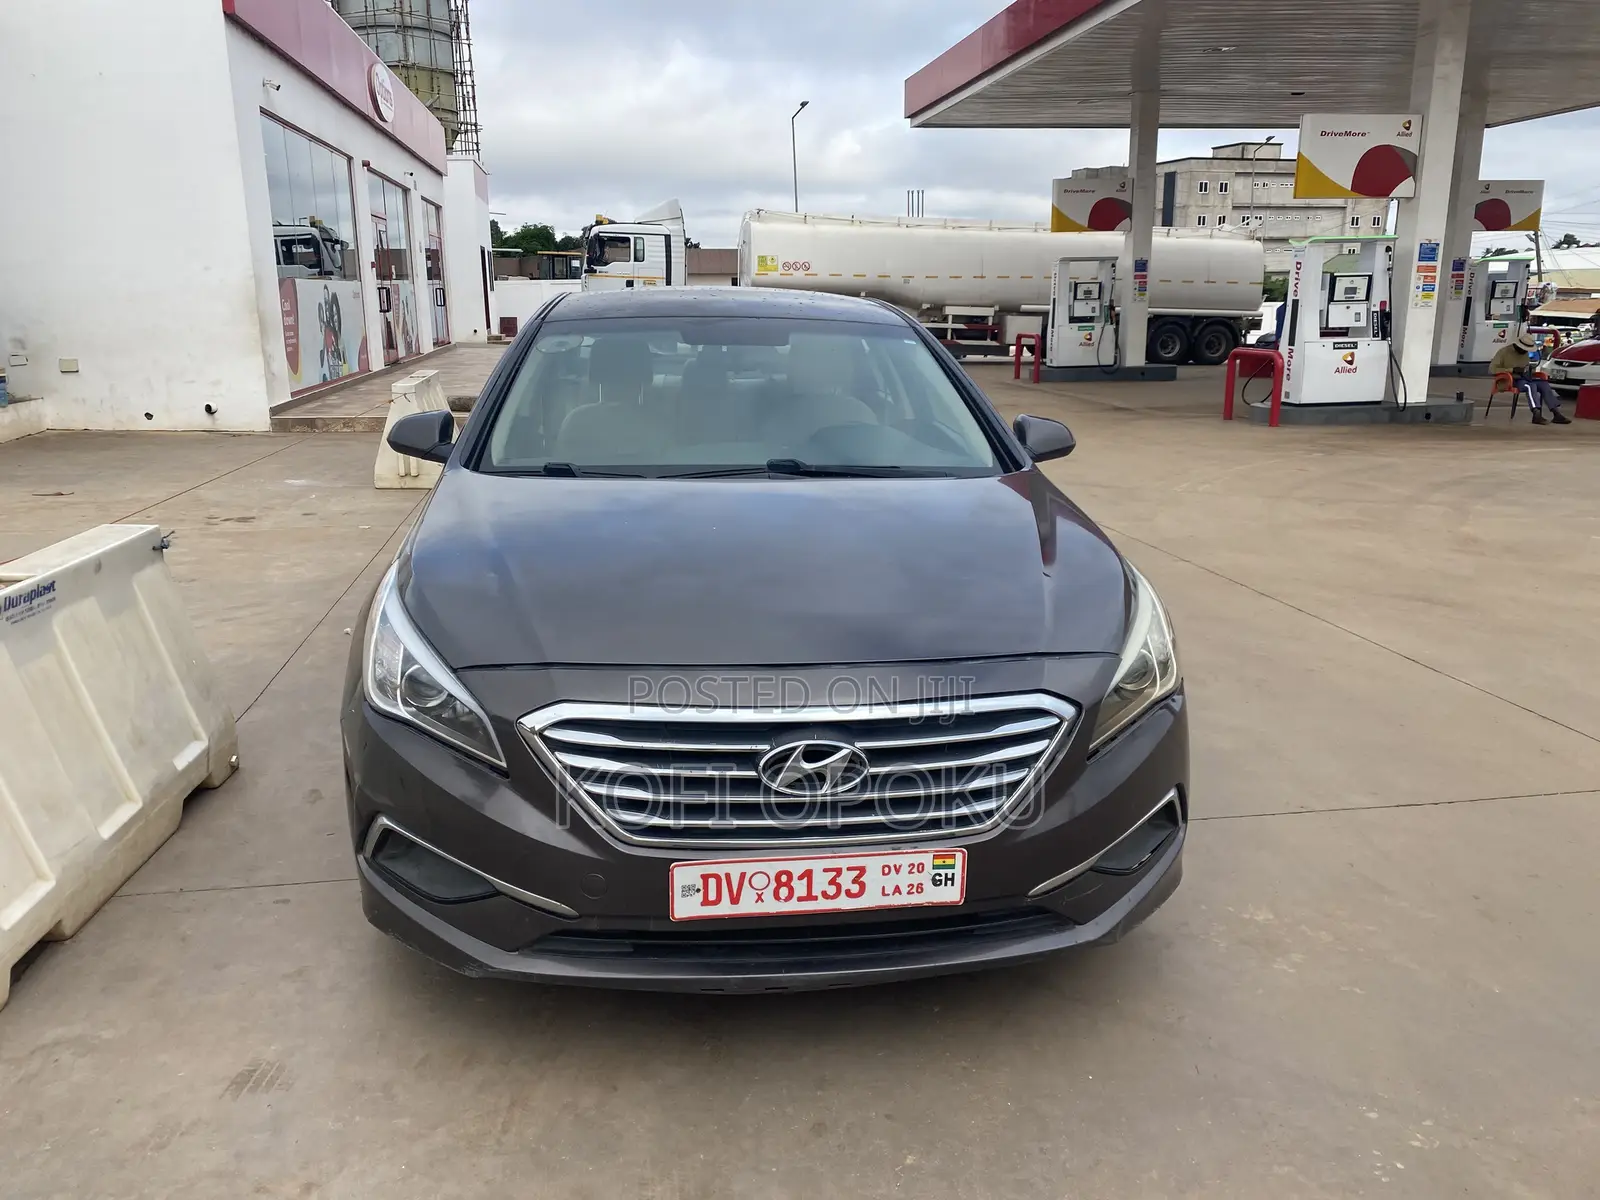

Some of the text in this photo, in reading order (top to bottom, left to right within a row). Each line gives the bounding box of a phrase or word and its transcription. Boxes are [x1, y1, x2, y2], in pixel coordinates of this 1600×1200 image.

[1320, 130, 1367, 138] DriveMore
[1292, 261, 1303, 298] Drive
[1286, 347, 1294, 381] More
[1334, 366, 1358, 374] Allied
[3, 580, 57, 612] Duraplast
[881, 862, 925, 877] DV 20
[700, 865, 867, 907] DV 8133
[931, 872, 955, 888] GH
[881, 882, 924, 897] LA 26
